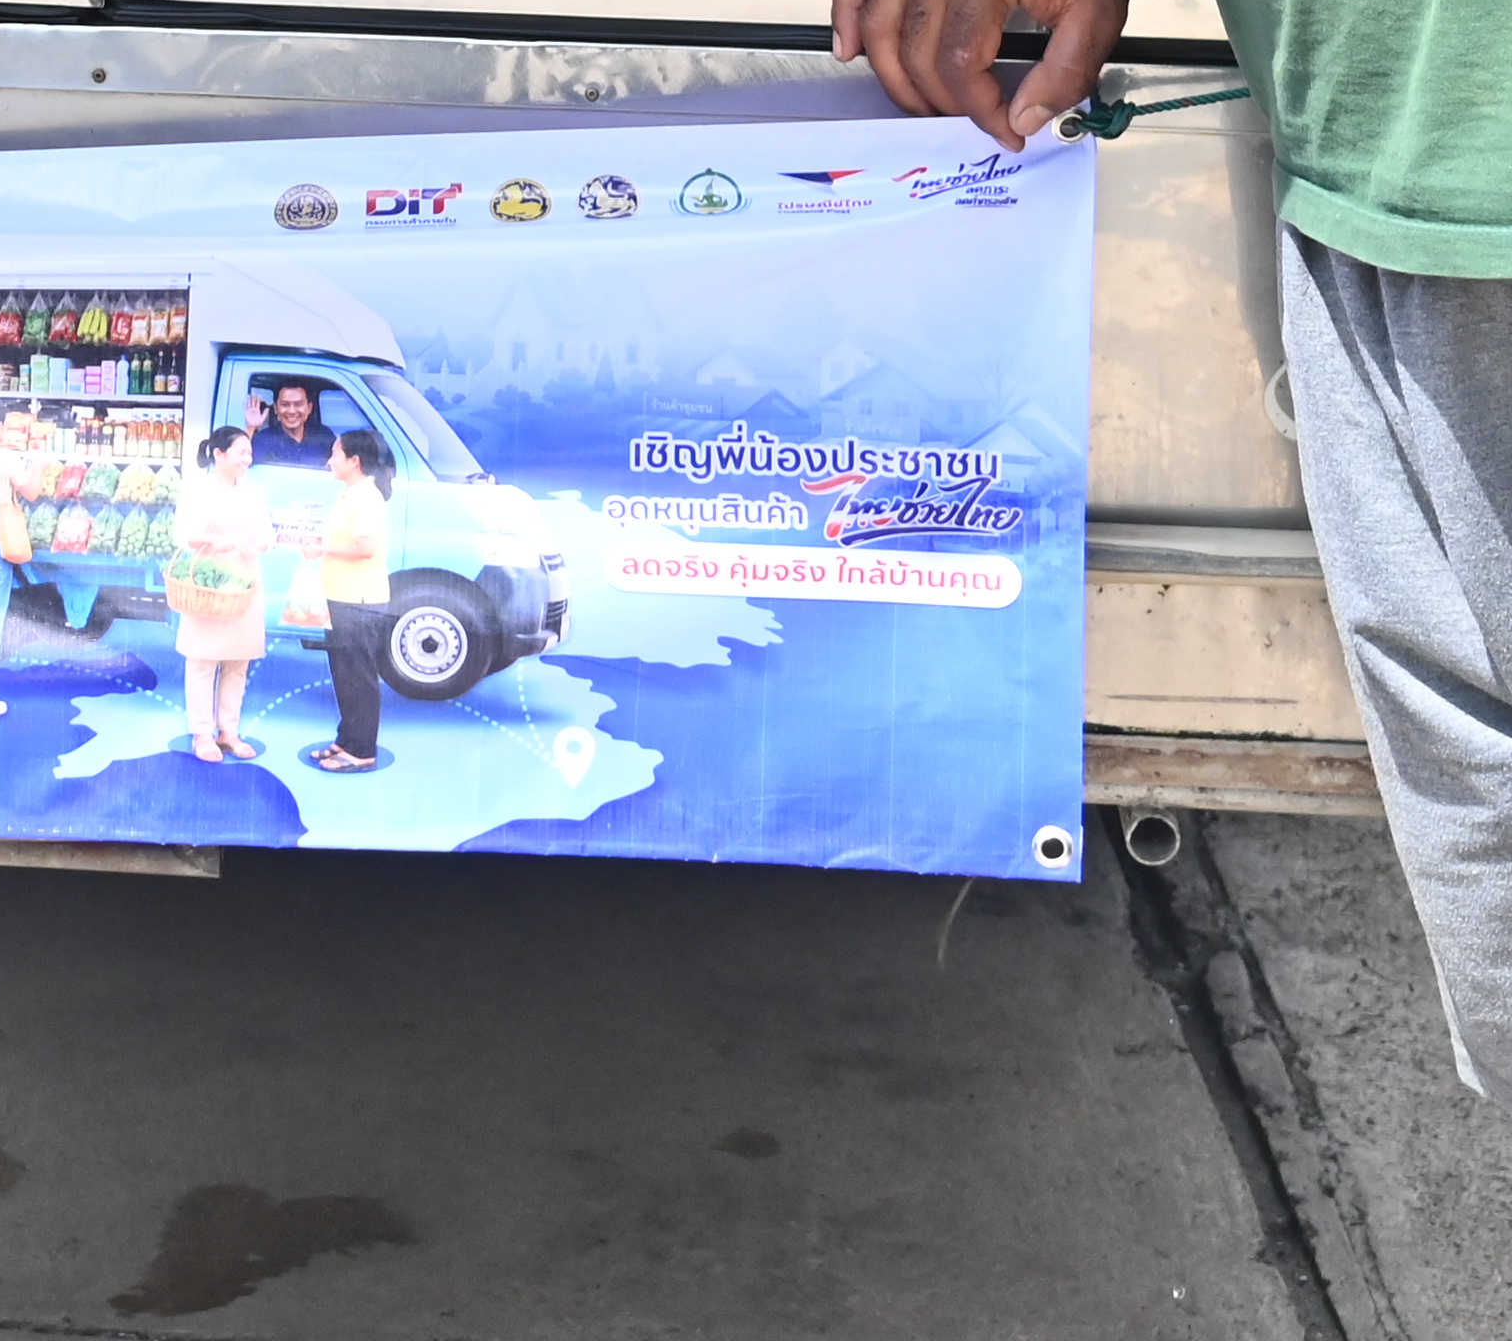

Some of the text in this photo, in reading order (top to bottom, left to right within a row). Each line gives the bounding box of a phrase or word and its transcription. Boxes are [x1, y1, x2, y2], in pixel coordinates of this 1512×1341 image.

[632, 423, 999, 479] เชิญพี่น้องประชาชน
[607, 494, 805, 532] อุดหนุนสินค้า
[621, 555, 1004, 598] ลดจริง คุ้มจริง ใกล้บ้านคุณ
